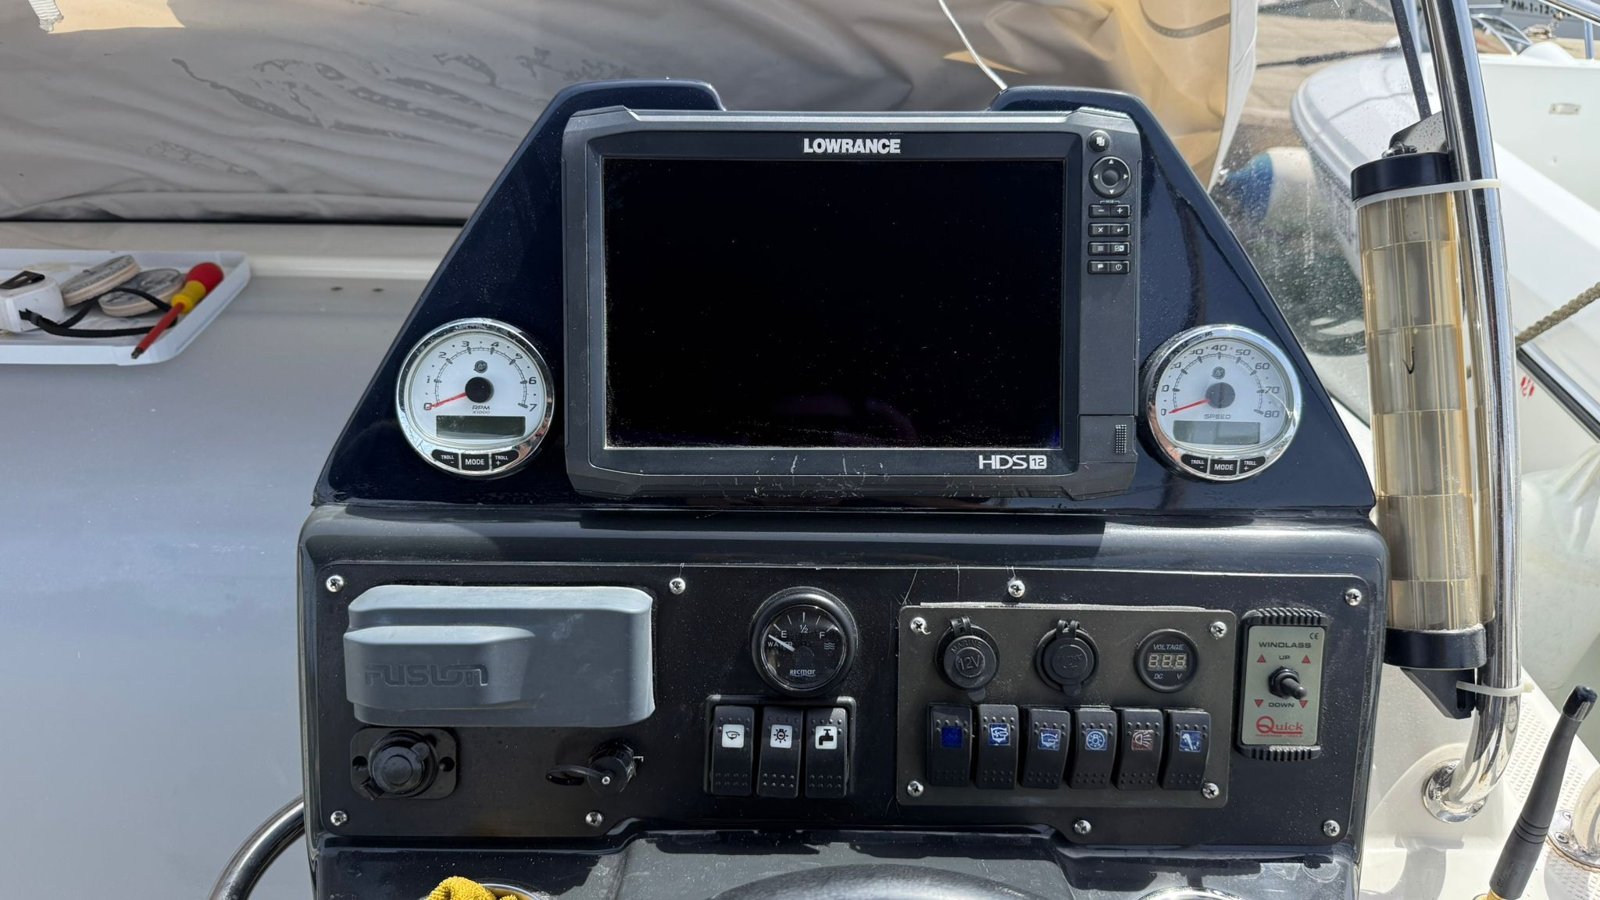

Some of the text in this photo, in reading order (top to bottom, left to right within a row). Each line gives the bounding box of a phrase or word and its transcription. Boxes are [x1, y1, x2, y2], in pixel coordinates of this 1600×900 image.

[803, 138, 901, 154] LOWRANCE
[528, 377, 537, 385] 6
[1264, 386, 1280, 394] 70
[529, 404, 538, 412] 7
[978, 454, 1046, 470] HDS 12
[781, 630, 788, 639] E
[819, 631, 826, 639] F
[1309, 632, 1319, 640] CE
[1258, 641, 1312, 649] WINDLASS
[958, 654, 981, 670] 12V
